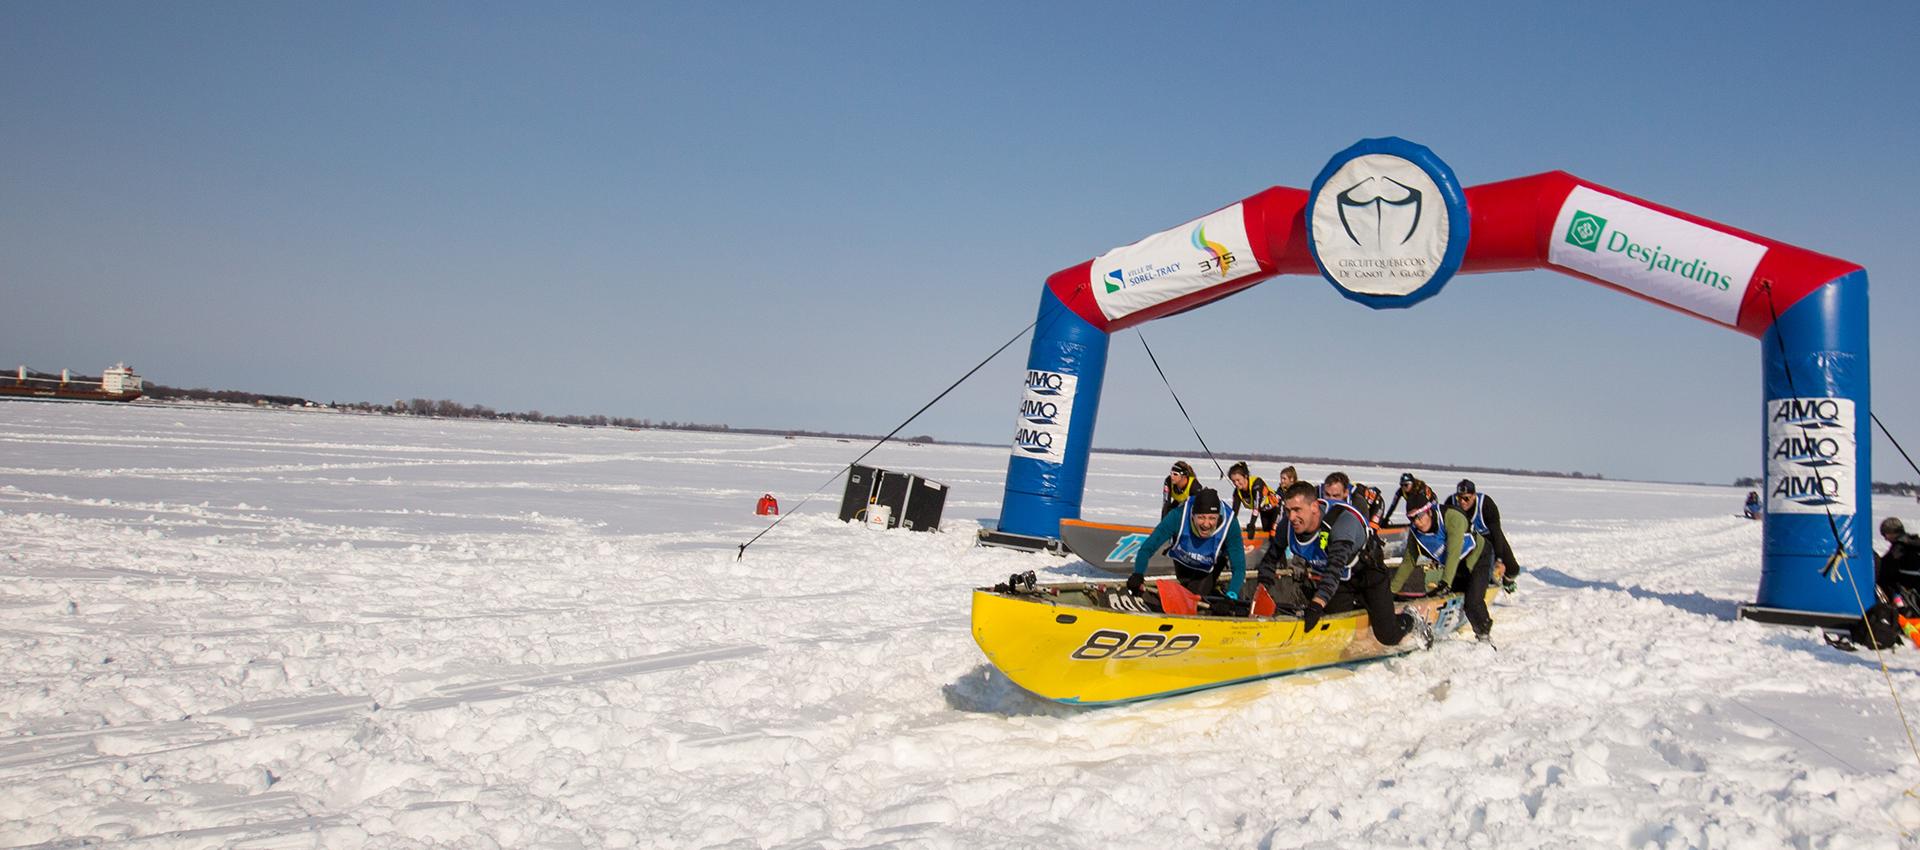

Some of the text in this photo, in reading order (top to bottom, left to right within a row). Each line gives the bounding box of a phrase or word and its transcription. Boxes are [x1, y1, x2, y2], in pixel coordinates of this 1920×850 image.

[1198, 252, 1236, 272] 375
[1338, 259, 1373, 268] CIRCUIT
[1607, 230, 1733, 292] Desjardins
[1129, 262, 1180, 286] SOREL-TRACY
[1339, 270, 1349, 278] DE
[1354, 270, 1383, 278] CANOT
[1400, 269, 1426, 278] GLACE
[1024, 371, 1063, 391] AMQ
[1020, 400, 1058, 419] AMQ
[1773, 400, 1840, 422] AMQ
[1015, 428, 1053, 449] AMQ
[1773, 437, 1839, 460] AMQ
[1772, 476, 1839, 498] AMQ
[1071, 628, 1201, 660] 888
